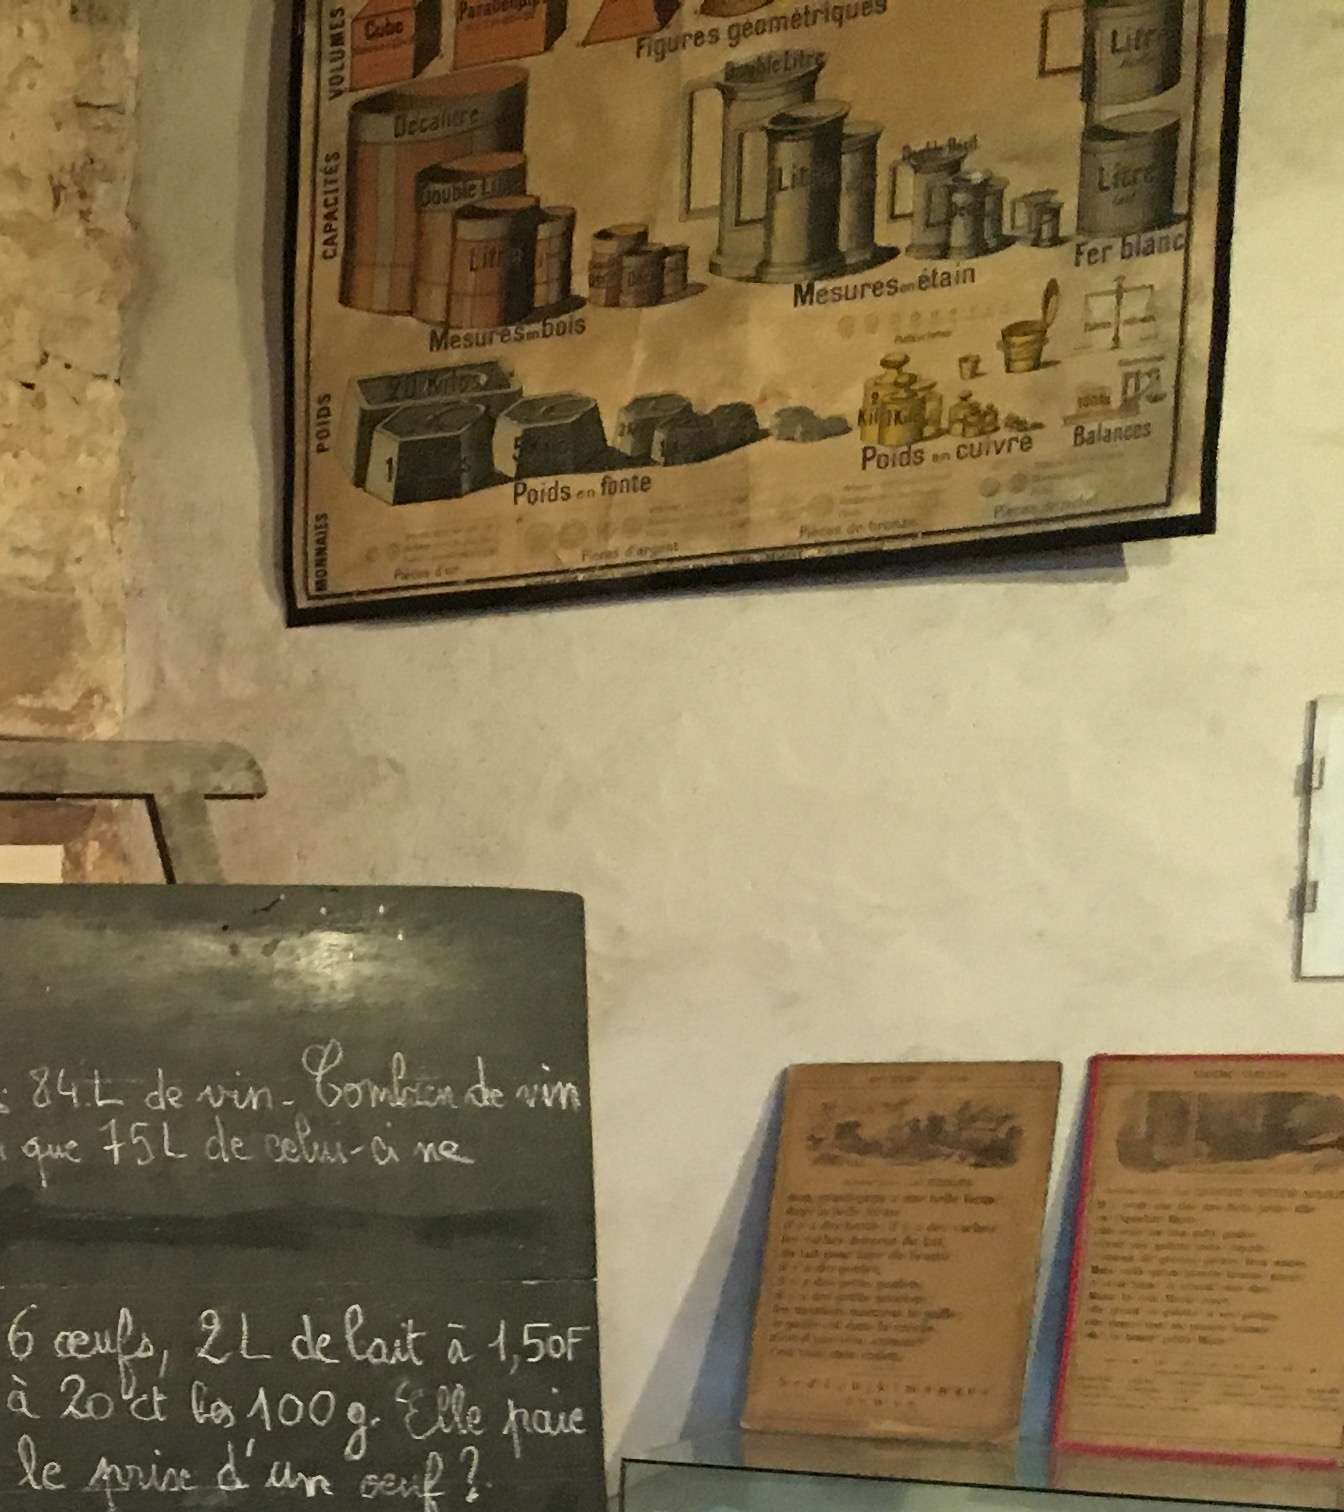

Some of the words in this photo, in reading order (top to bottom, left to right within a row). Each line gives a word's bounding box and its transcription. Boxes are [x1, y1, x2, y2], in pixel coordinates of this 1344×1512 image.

[328, 6, 346, 101] VOLUMES
[635, 24, 721, 62] Figures
[322, 151, 341, 261] CAPACITÉS
[1074, 242, 1111, 267] Fer
[1120, 232, 1186, 261] blanc
[793, 276, 898, 309] Mesures
[917, 263, 976, 292] étain
[428, 325, 525, 352] Mesures
[541, 315, 587, 340] bois
[316, 393, 332, 453] POIDS
[1073, 420, 1152, 447] Balances
[861, 444, 925, 471] Poids
[955, 434, 1034, 461] cuivre
[513, 480, 572, 505] Poids
[600, 474, 652, 497] fonte
[314, 512, 329, 593] MONNAIES
[144, 1067, 184, 1111] de
[464, 1055, 505, 1110] de
[515, 1062, 583, 1112] vin
[21, 1136, 82, 1188] que
[205, 1115, 257, 1163] de
[413, 1140, 477, 1164] ne
[8, 1303, 38, 1362] 6
[292, 1313, 341, 1364] de
[343, 1303, 427, 1366] lait
[17, 1433, 68, 1491] le
